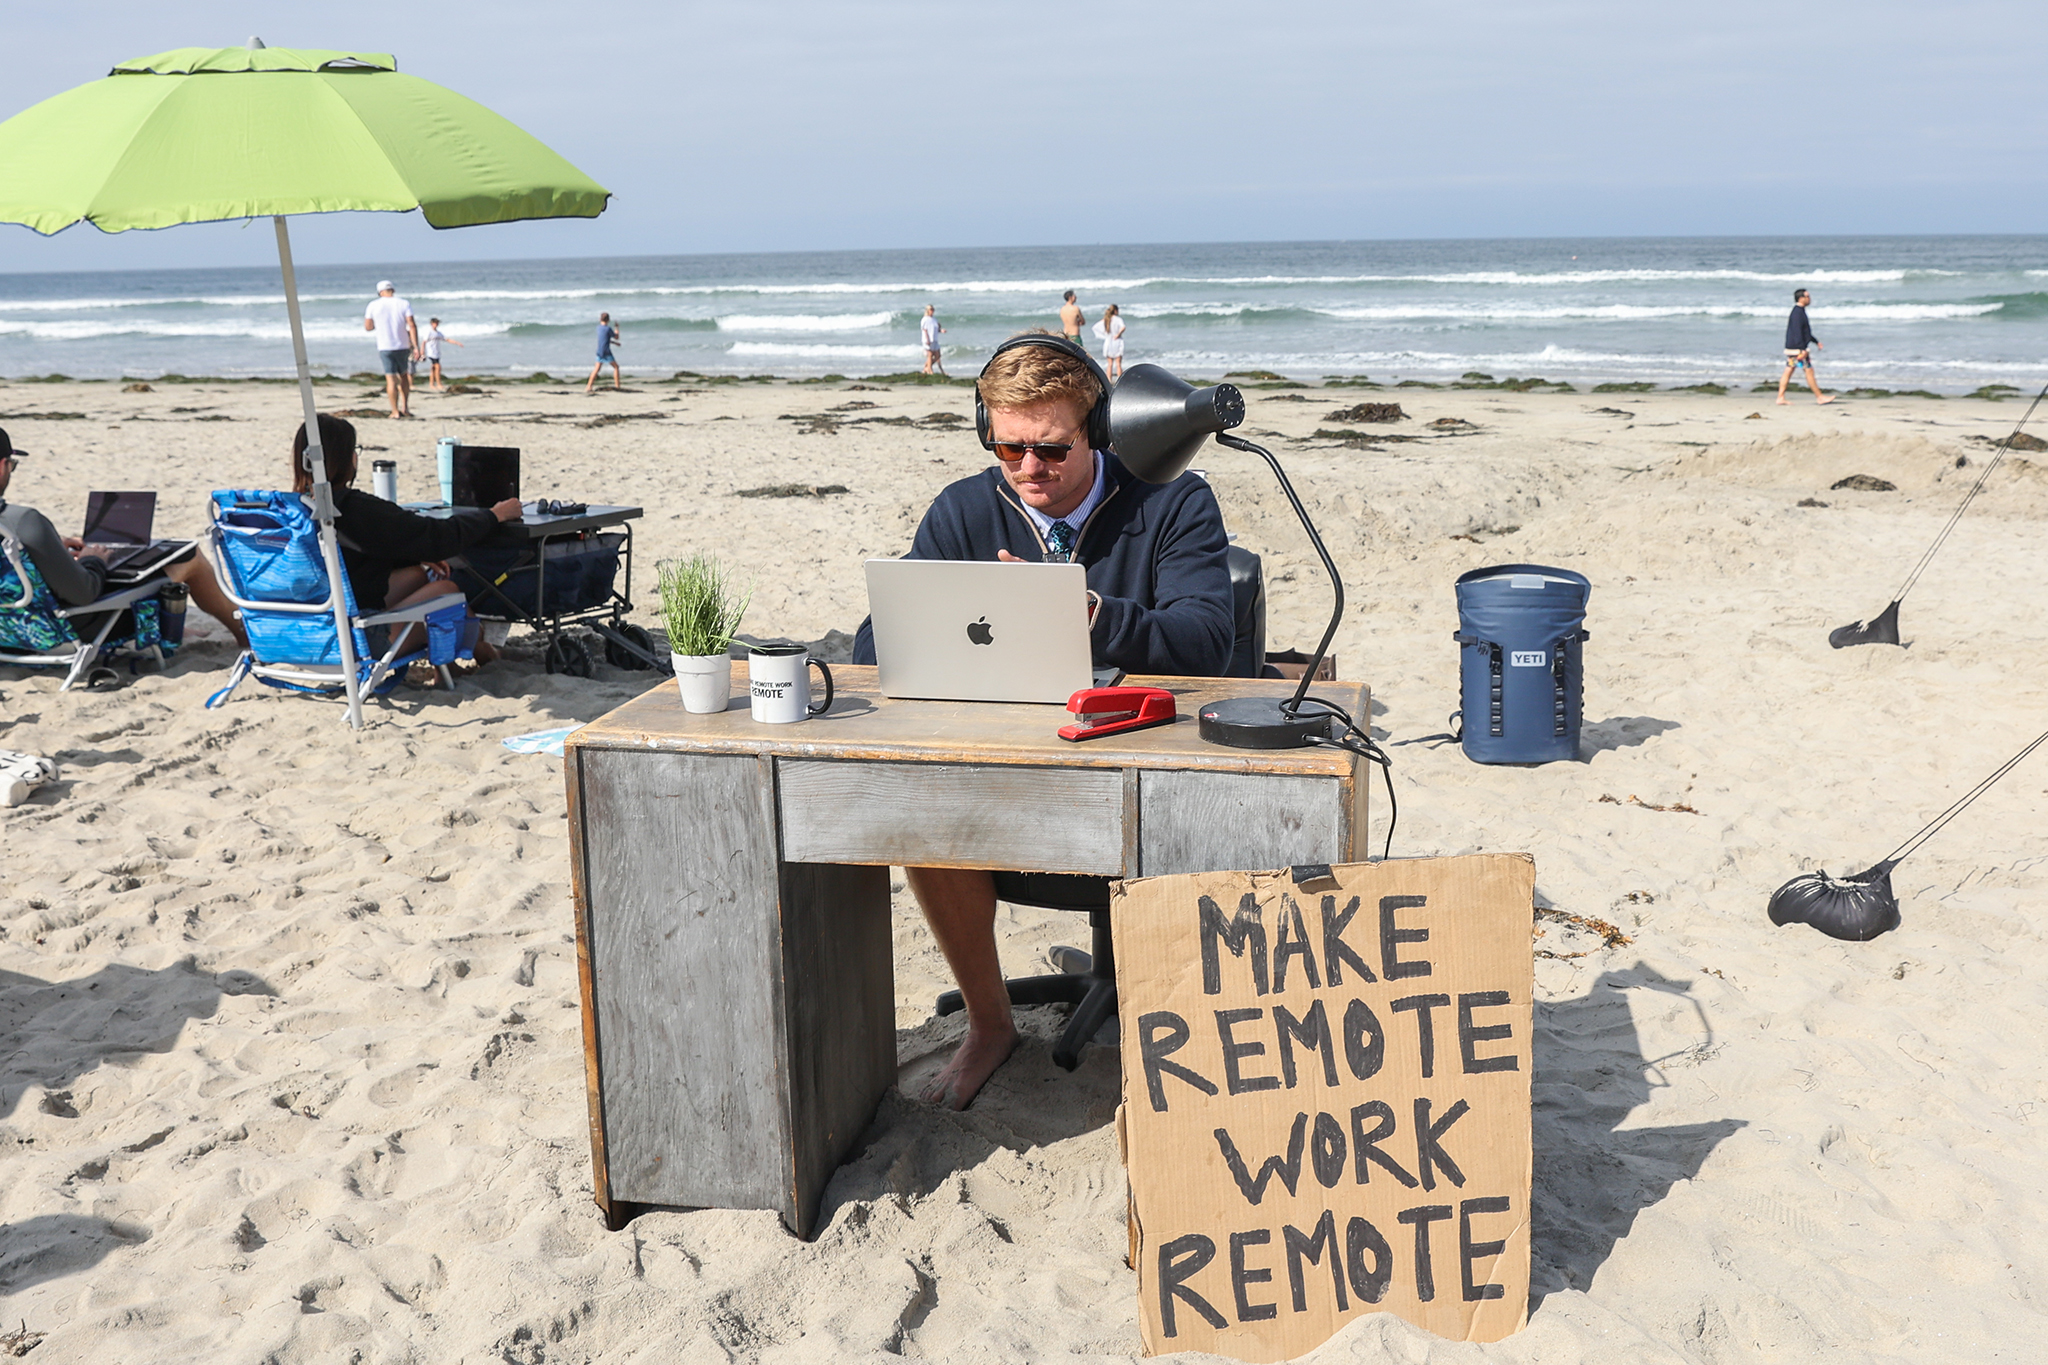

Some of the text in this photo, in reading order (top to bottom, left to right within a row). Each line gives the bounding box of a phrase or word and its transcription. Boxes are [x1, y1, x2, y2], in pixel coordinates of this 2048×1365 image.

[752, 687, 783, 698] REMOTE
[1514, 654, 1542, 663] YETI
[1198, 892, 1432, 996] MAKE
[1138, 990, 1519, 1112] REMOTE
[1214, 1097, 1471, 1206] WORK
[1158, 1196, 1510, 1338] REMOTE
